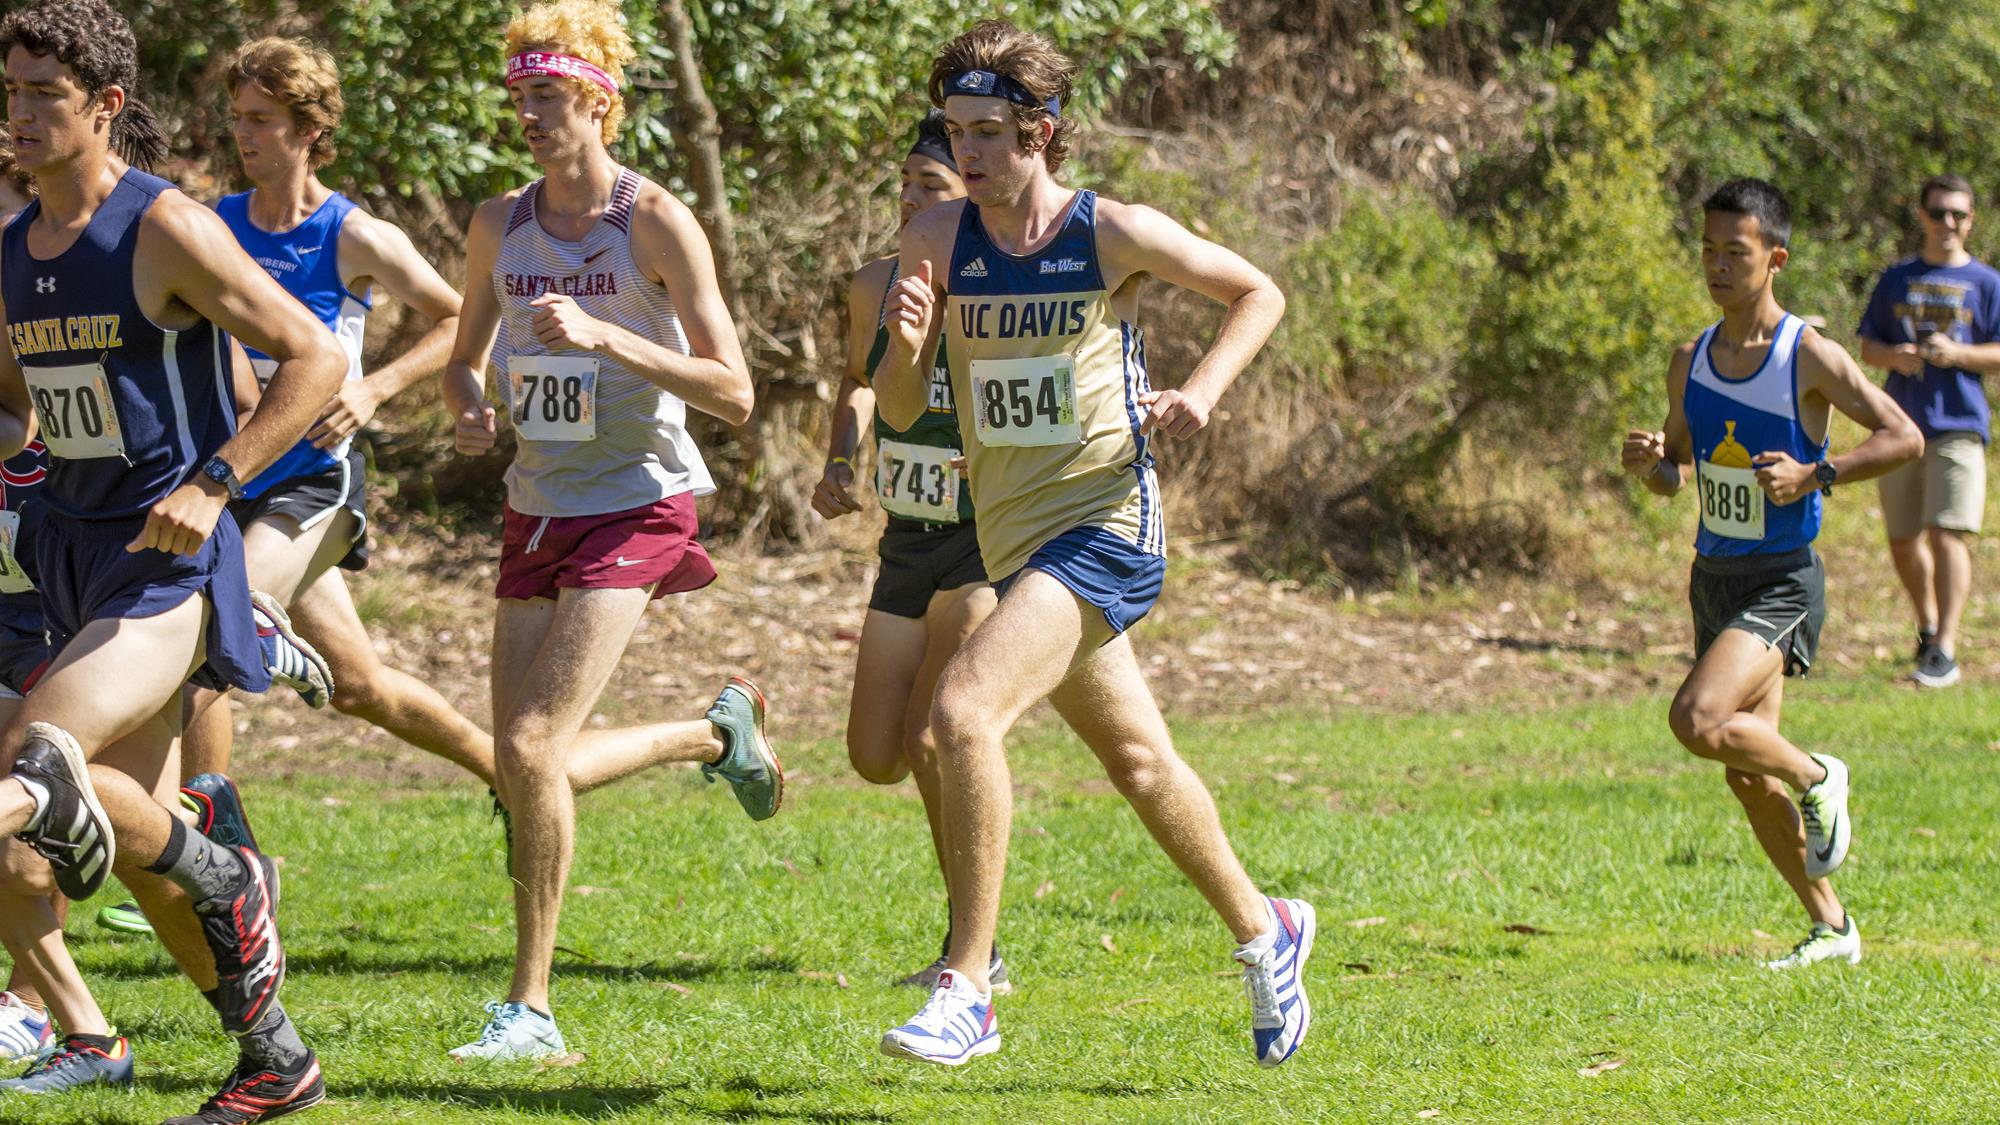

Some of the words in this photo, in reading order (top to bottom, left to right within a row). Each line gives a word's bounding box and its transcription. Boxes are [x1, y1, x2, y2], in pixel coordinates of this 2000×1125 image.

[505, 273, 560, 296] SANTA
[563, 272, 617, 296] CLARA
[960, 269, 988, 277] adidas
[15, 318, 68, 355] SANTA
[66, 314, 123, 350] CRUZ
[960, 303, 992, 338] UC
[998, 300, 1086, 338] DAVIS
[38, 386, 103, 439] 870
[522, 375, 581, 423] 788
[985, 376, 1061, 429] 854
[892, 458, 945, 507] 743
[1706, 478, 1751, 524] 889
